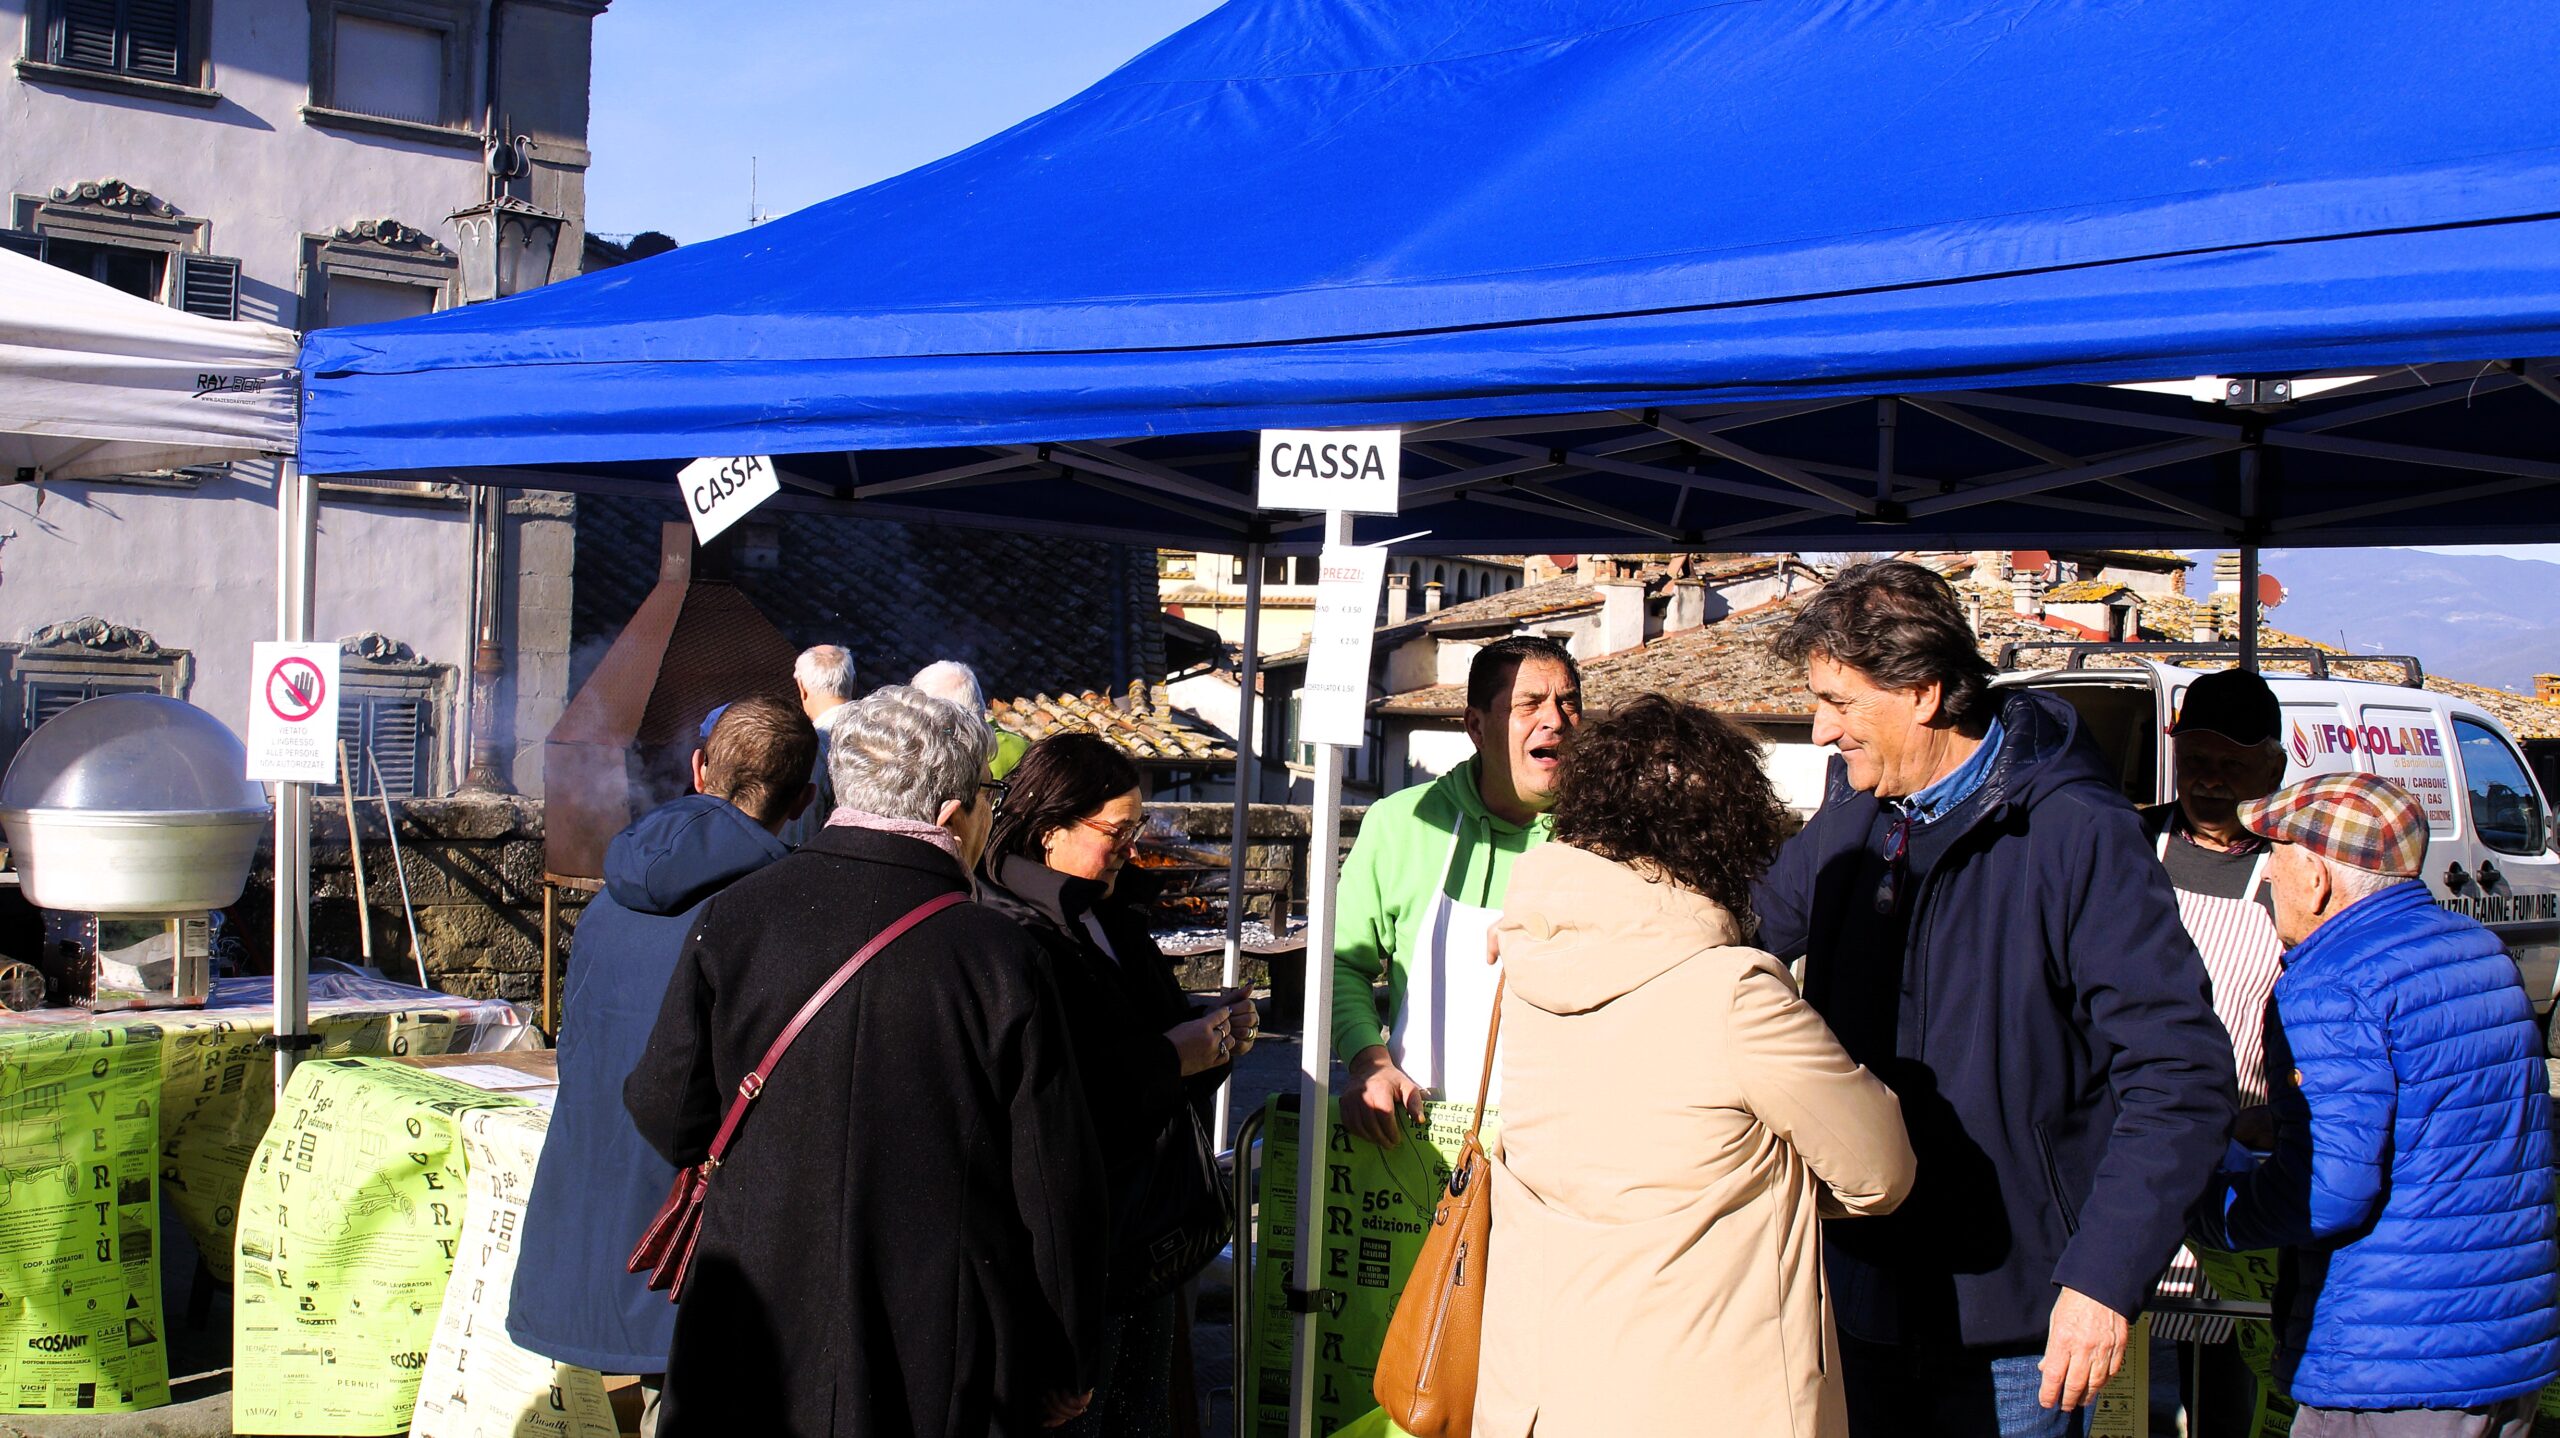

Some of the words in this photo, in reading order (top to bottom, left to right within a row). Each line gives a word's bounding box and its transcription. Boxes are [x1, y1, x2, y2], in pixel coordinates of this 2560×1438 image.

[197, 374, 227, 390] RAY
[232, 376, 266, 393] BOT
[1271, 443, 1385, 480] CASSA
[694, 455, 762, 514] CASSA
[279, 726, 308, 735] VIETATO
[266, 749, 284, 757] ALLE
[285, 749, 320, 758] PERSONE
[260, 760, 275, 768] NON
[277, 760, 325, 768] AUTORIZZATE
[2394, 758, 2401, 767] di
[2402, 758, 2428, 768] Bartolini
[2413, 777, 2447, 789] CARBONE
[2427, 793, 2443, 805] GAS
[2473, 896, 2509, 922] CANNE
[2513, 893, 2557, 921] FUMARIE
[1451, 1104, 1464, 1112] di
[307, 1115, 333, 1131] edizione
[1410, 1120, 1421, 1129] le
[1416, 1132, 1435, 1141] del
[1361, 1215, 1421, 1234] edizione
[23, 1260, 45, 1270] COOP.
[46, 1254, 84, 1265] LAVORATORI
[42, 1264, 70, 1274] ANGHIARI
[28, 1333, 89, 1352] ECOSANIT
[390, 1351, 428, 1369] ECOSA
[392, 1403, 415, 1411] VICH
[524, 1411, 570, 1430] Busatti
